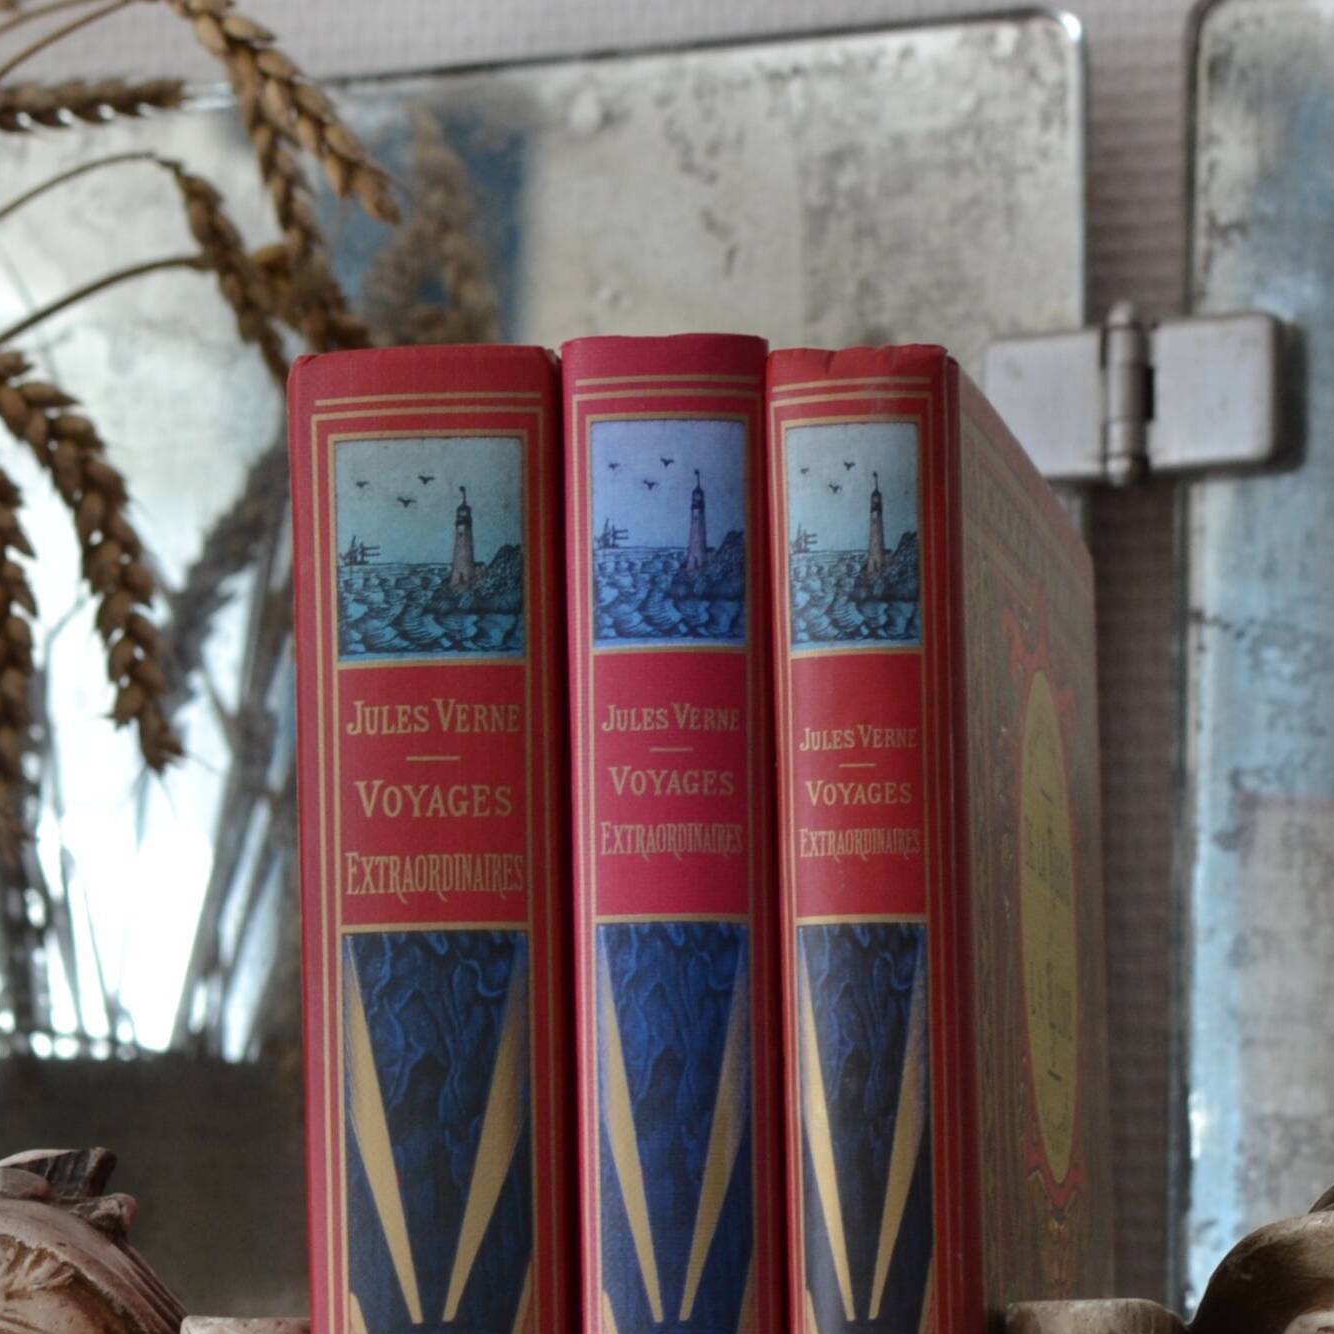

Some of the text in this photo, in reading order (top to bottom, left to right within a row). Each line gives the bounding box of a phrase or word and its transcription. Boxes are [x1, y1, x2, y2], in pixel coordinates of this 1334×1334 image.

[346, 698, 520, 736] JULES VERNE
[601, 703, 741, 732] JULES VERNE
[799, 724, 917, 751] JULES VERNE
[354, 779, 513, 818] VOYAGES
[608, 766, 735, 797] VOYAGES
[805, 780, 913, 807] VOYAGES
[600, 821, 744, 862] EXTRAORDINAIRES
[799, 828, 920, 863] EXTRAORDINAIRES
[345, 852, 525, 904] EXTRAORDINAIRES
